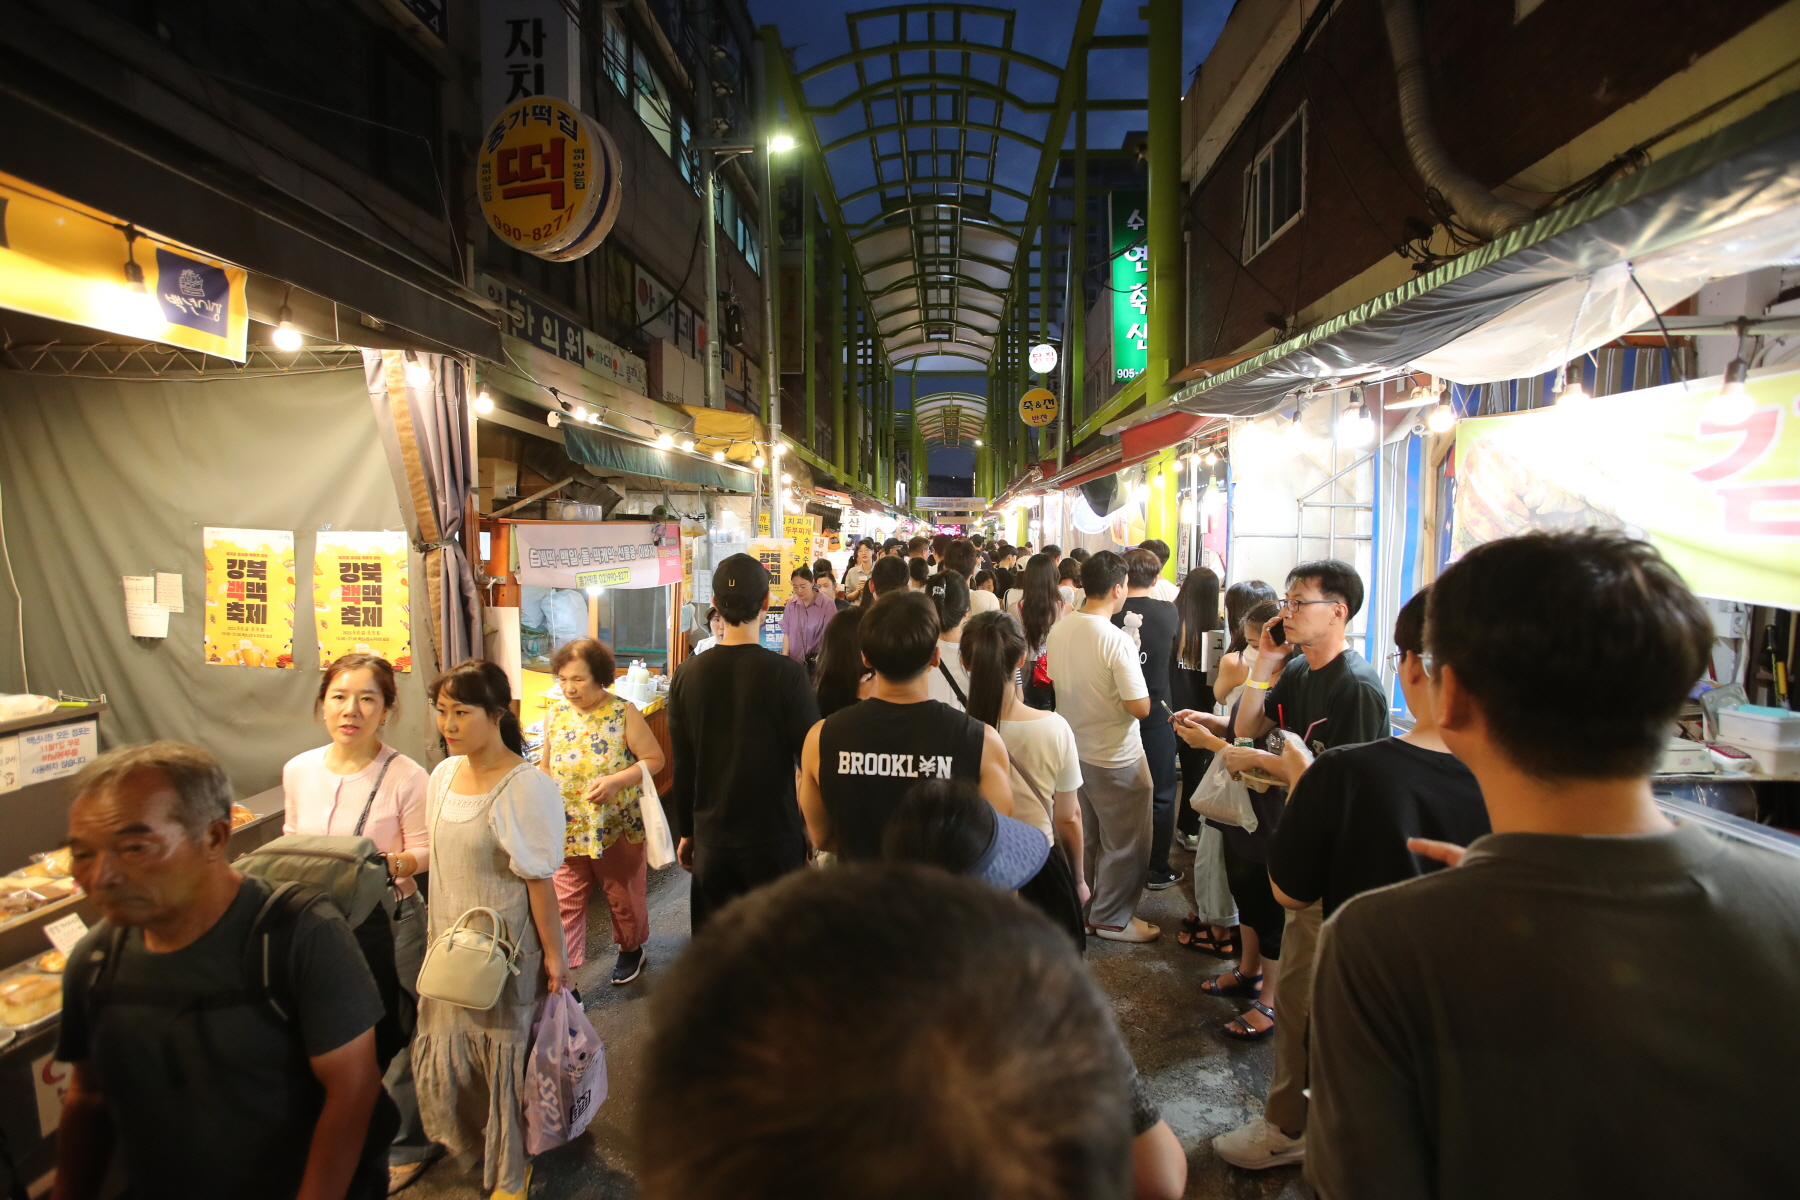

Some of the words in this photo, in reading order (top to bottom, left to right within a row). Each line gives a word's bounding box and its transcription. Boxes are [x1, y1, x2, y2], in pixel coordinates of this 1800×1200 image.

[487, 105, 579, 154] 종가떡집
[497, 137, 566, 210] 떡
[493, 203, 575, 241] 990-8277
[510, 299, 583, 368] 한의원
[1031, 414, 1048, 423] 반찬
[559, 548, 578, 566] 백일
[759, 552, 781, 564] 강북
[226, 558, 268, 580] 강북
[339, 562, 382, 583] 강북
[226, 580, 268, 602] 백맥
[340, 584, 383, 605] 백맥
[226, 601, 268, 624] 축제
[340, 605, 383, 628] 축제
[27, 734, 54, 745] 백년시장
[56, 729, 69, 739] 모든
[67, 738, 80, 747] 부로
[32, 763, 59, 774] 사용하지
